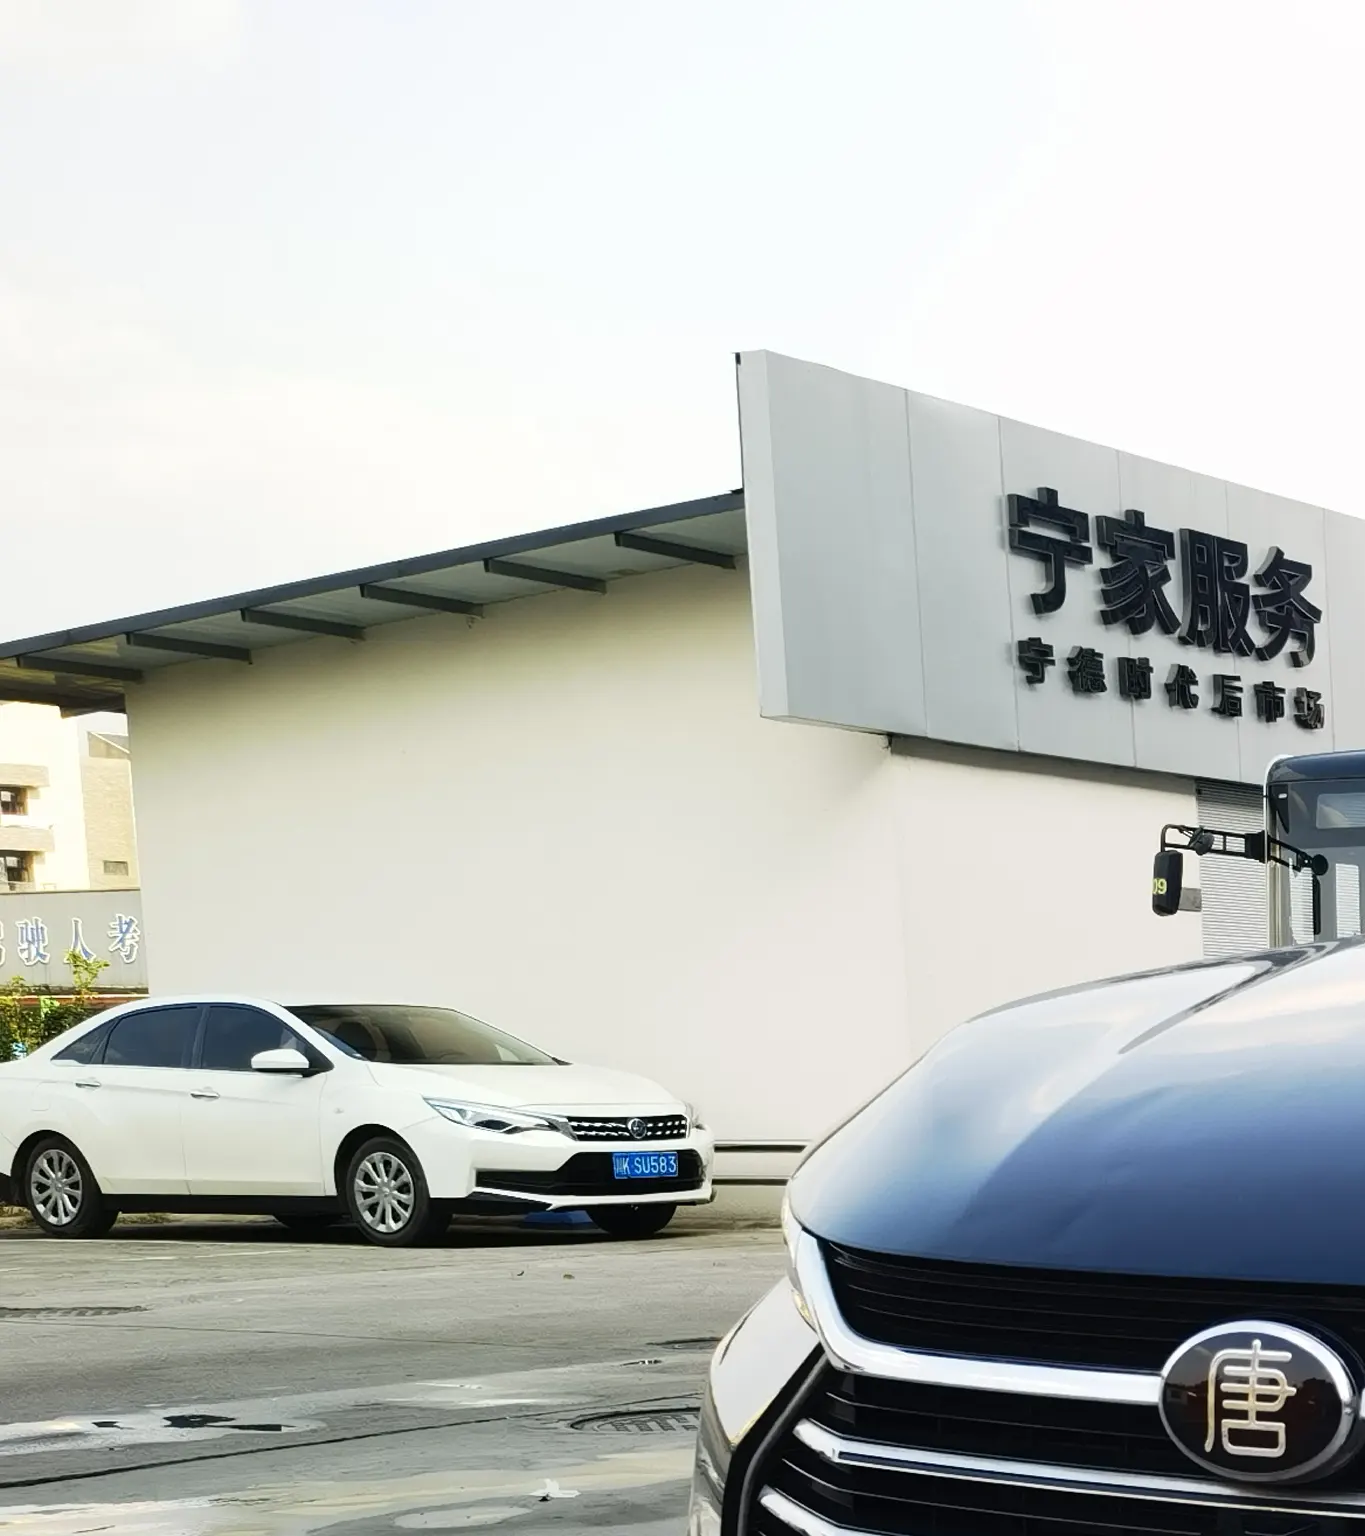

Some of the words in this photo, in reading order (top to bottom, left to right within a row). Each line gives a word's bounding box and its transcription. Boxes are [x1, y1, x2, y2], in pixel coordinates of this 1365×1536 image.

[1007, 486, 1323, 668] 宁家服务
[1018, 637, 1326, 730] 宁德时代后市场
[0, 913, 141, 966] 驶人考
[1204, 1338, 1297, 1458] 唐
